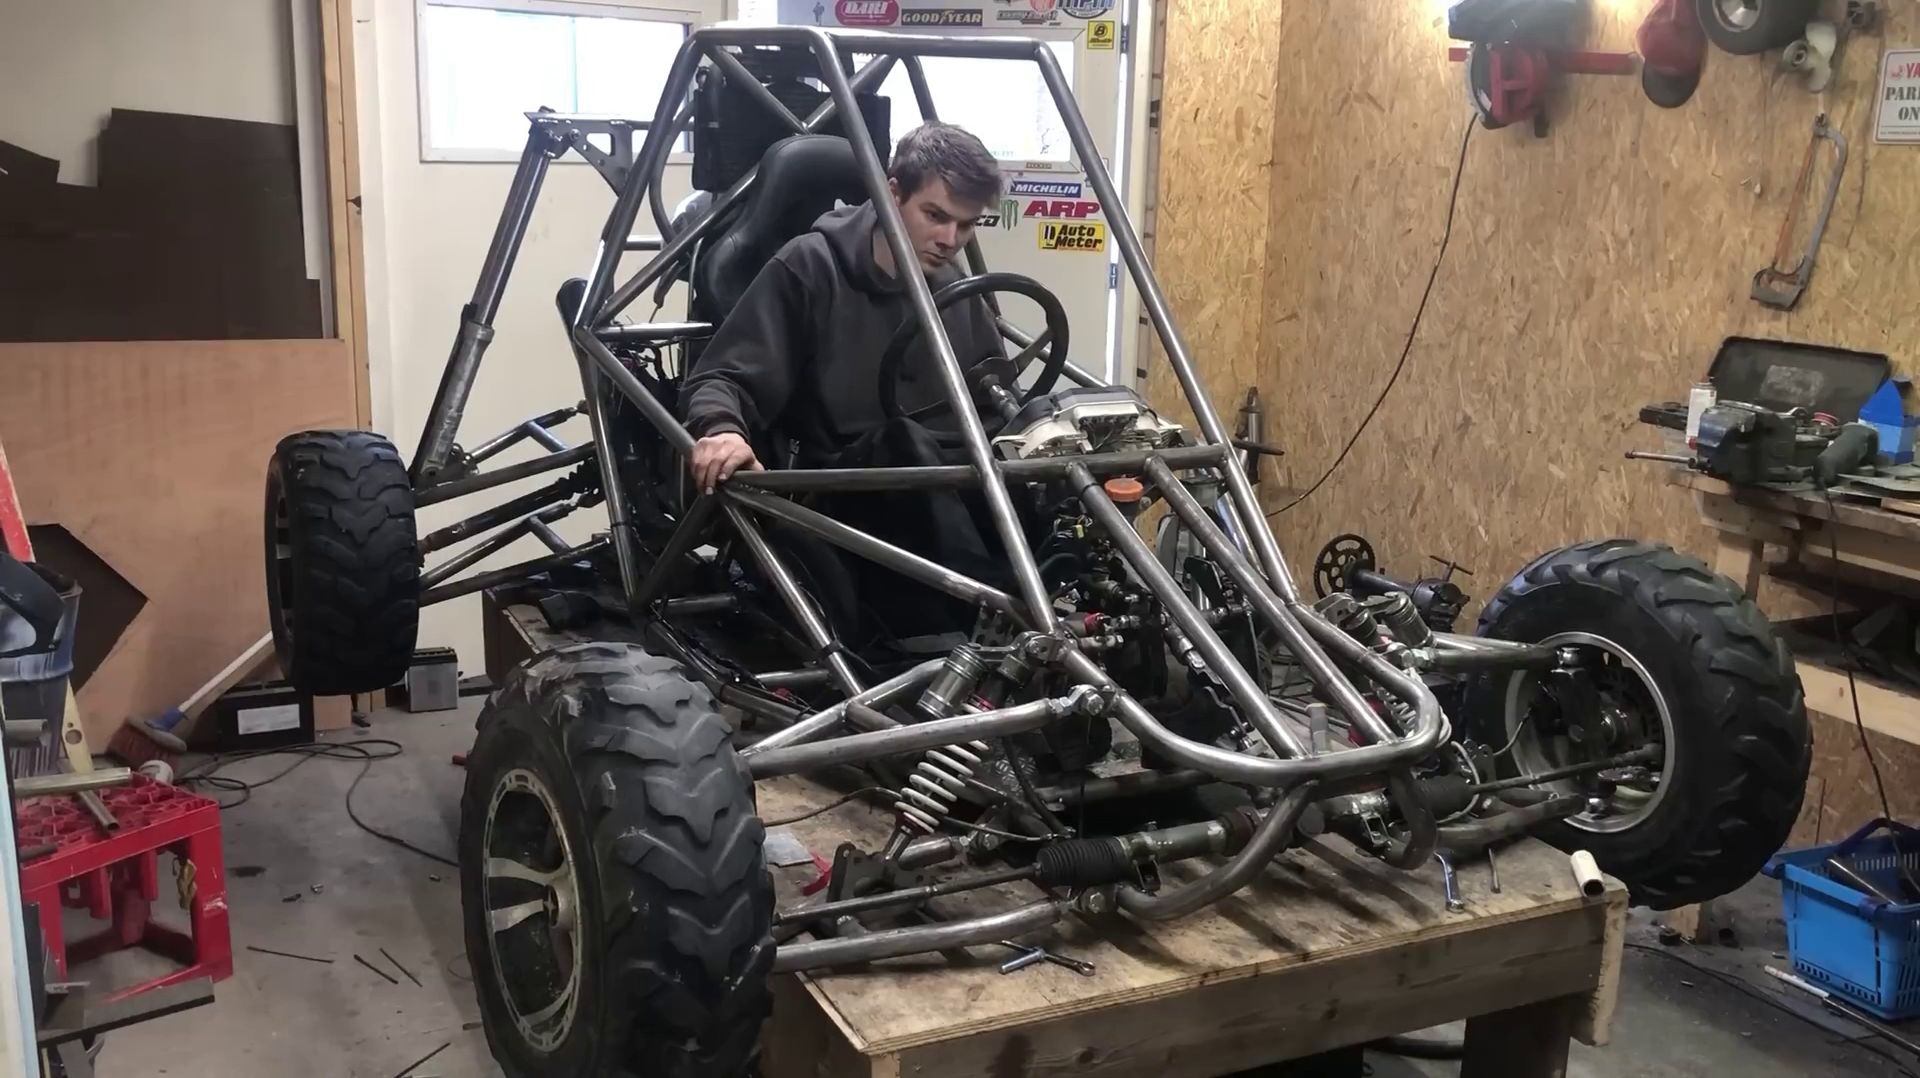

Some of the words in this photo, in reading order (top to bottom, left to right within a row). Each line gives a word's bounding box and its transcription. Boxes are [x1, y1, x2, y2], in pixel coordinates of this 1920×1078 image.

[1015, 184, 1079, 194] MICHELIN
[1024, 201, 1099, 217] ARP
[1058, 224, 1096, 237] Auto
[1055, 236, 1103, 249] Meter
